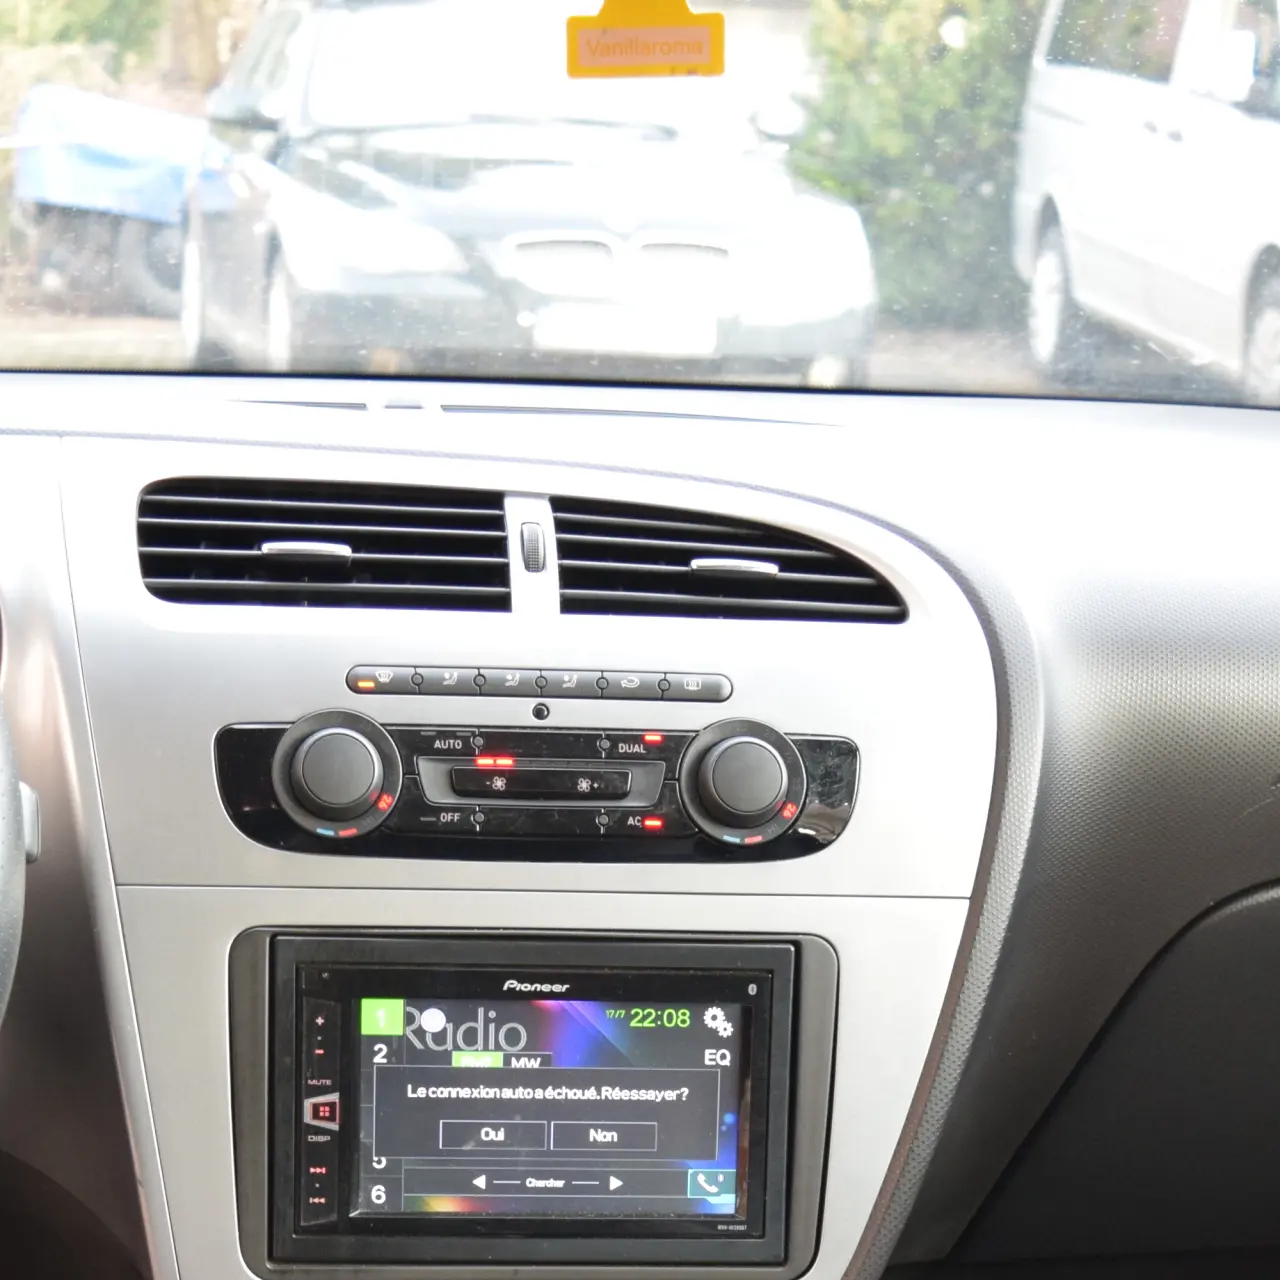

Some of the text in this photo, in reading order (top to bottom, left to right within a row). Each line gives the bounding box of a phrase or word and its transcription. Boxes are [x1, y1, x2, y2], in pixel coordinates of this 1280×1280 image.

[586, 37, 703, 58] Vanillaroma
[434, 739, 463, 749] AUTO
[619, 743, 646, 754] DUAL
[440, 812, 462, 823] OFF
[627, 816, 642, 826] AC
[503, 980, 569, 992] Pioneer
[375, 1009, 387, 1028] 1
[629, 1008, 690, 1027] 22:08
[373, 1043, 388, 1064] 2
[704, 1049, 731, 1067] EQ
[511, 1056, 542, 1068] MW
[428, 1084, 501, 1100] connexion
[601, 1086, 690, 1103] Réessayer?
[481, 1127, 505, 1141] Oui
[589, 1129, 618, 1143] Non
[371, 1185, 387, 1205] 6
